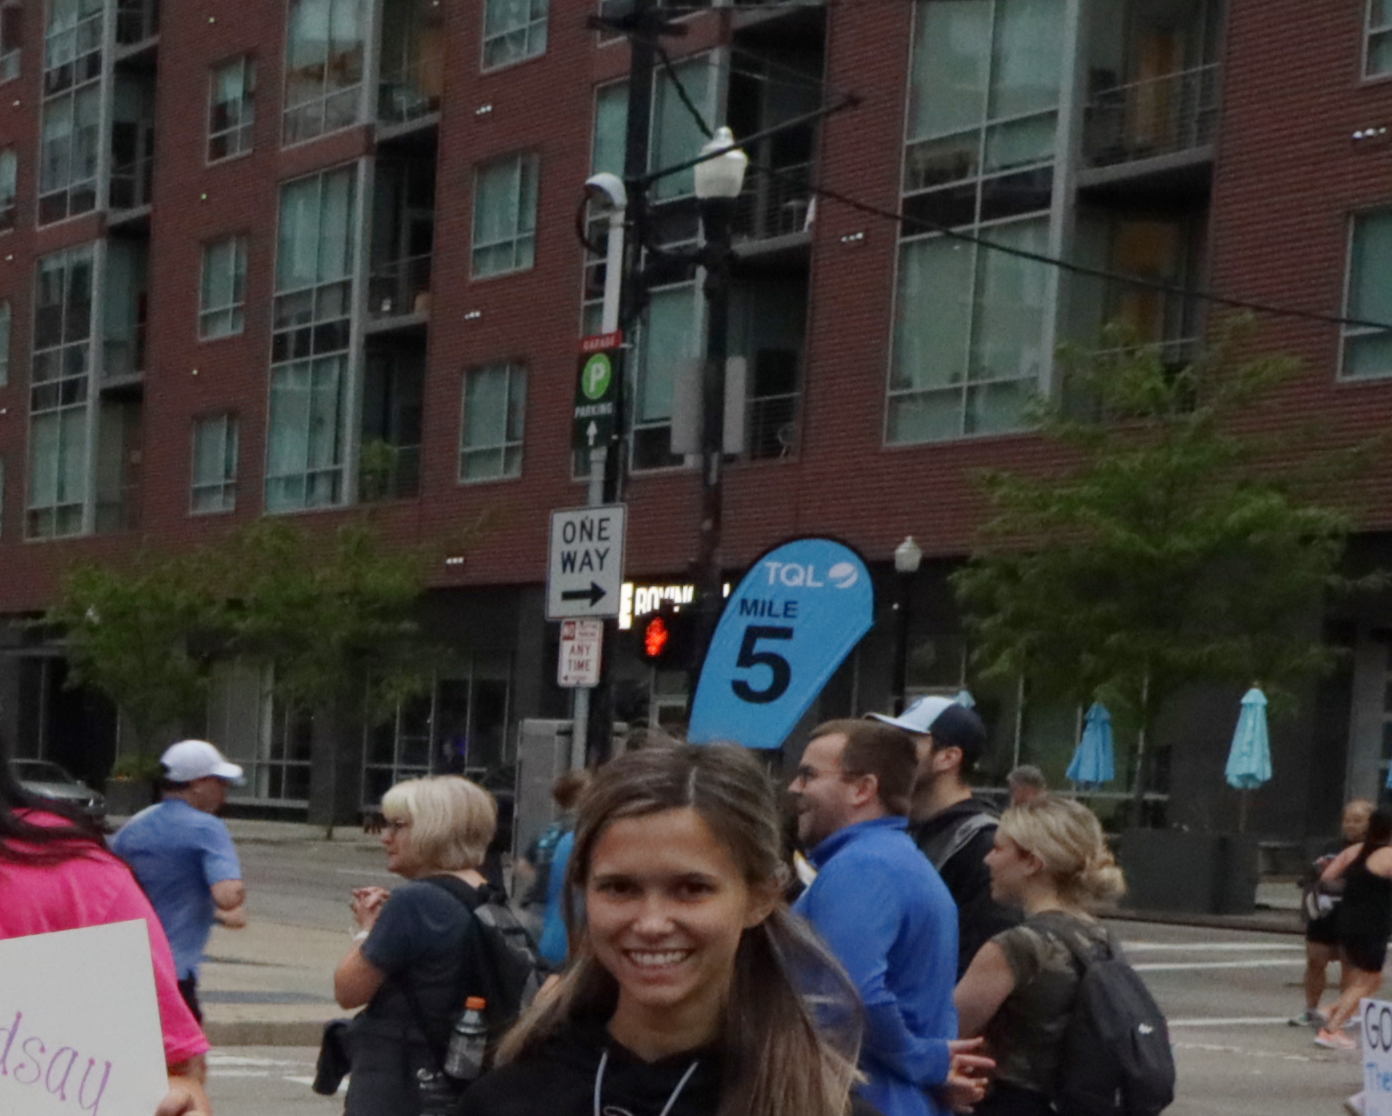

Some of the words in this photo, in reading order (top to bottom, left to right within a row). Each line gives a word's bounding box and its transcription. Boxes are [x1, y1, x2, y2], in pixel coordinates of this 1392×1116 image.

[575, 402, 613, 418] PARKING
[563, 518, 610, 544] ONE
[561, 548, 610, 573] WAY
[765, 561, 824, 588] TQL
[739, 598, 799, 619] MILE
[569, 644, 591, 656] ANY
[568, 659, 591, 672] TIME
[731, 625, 794, 705] 5
